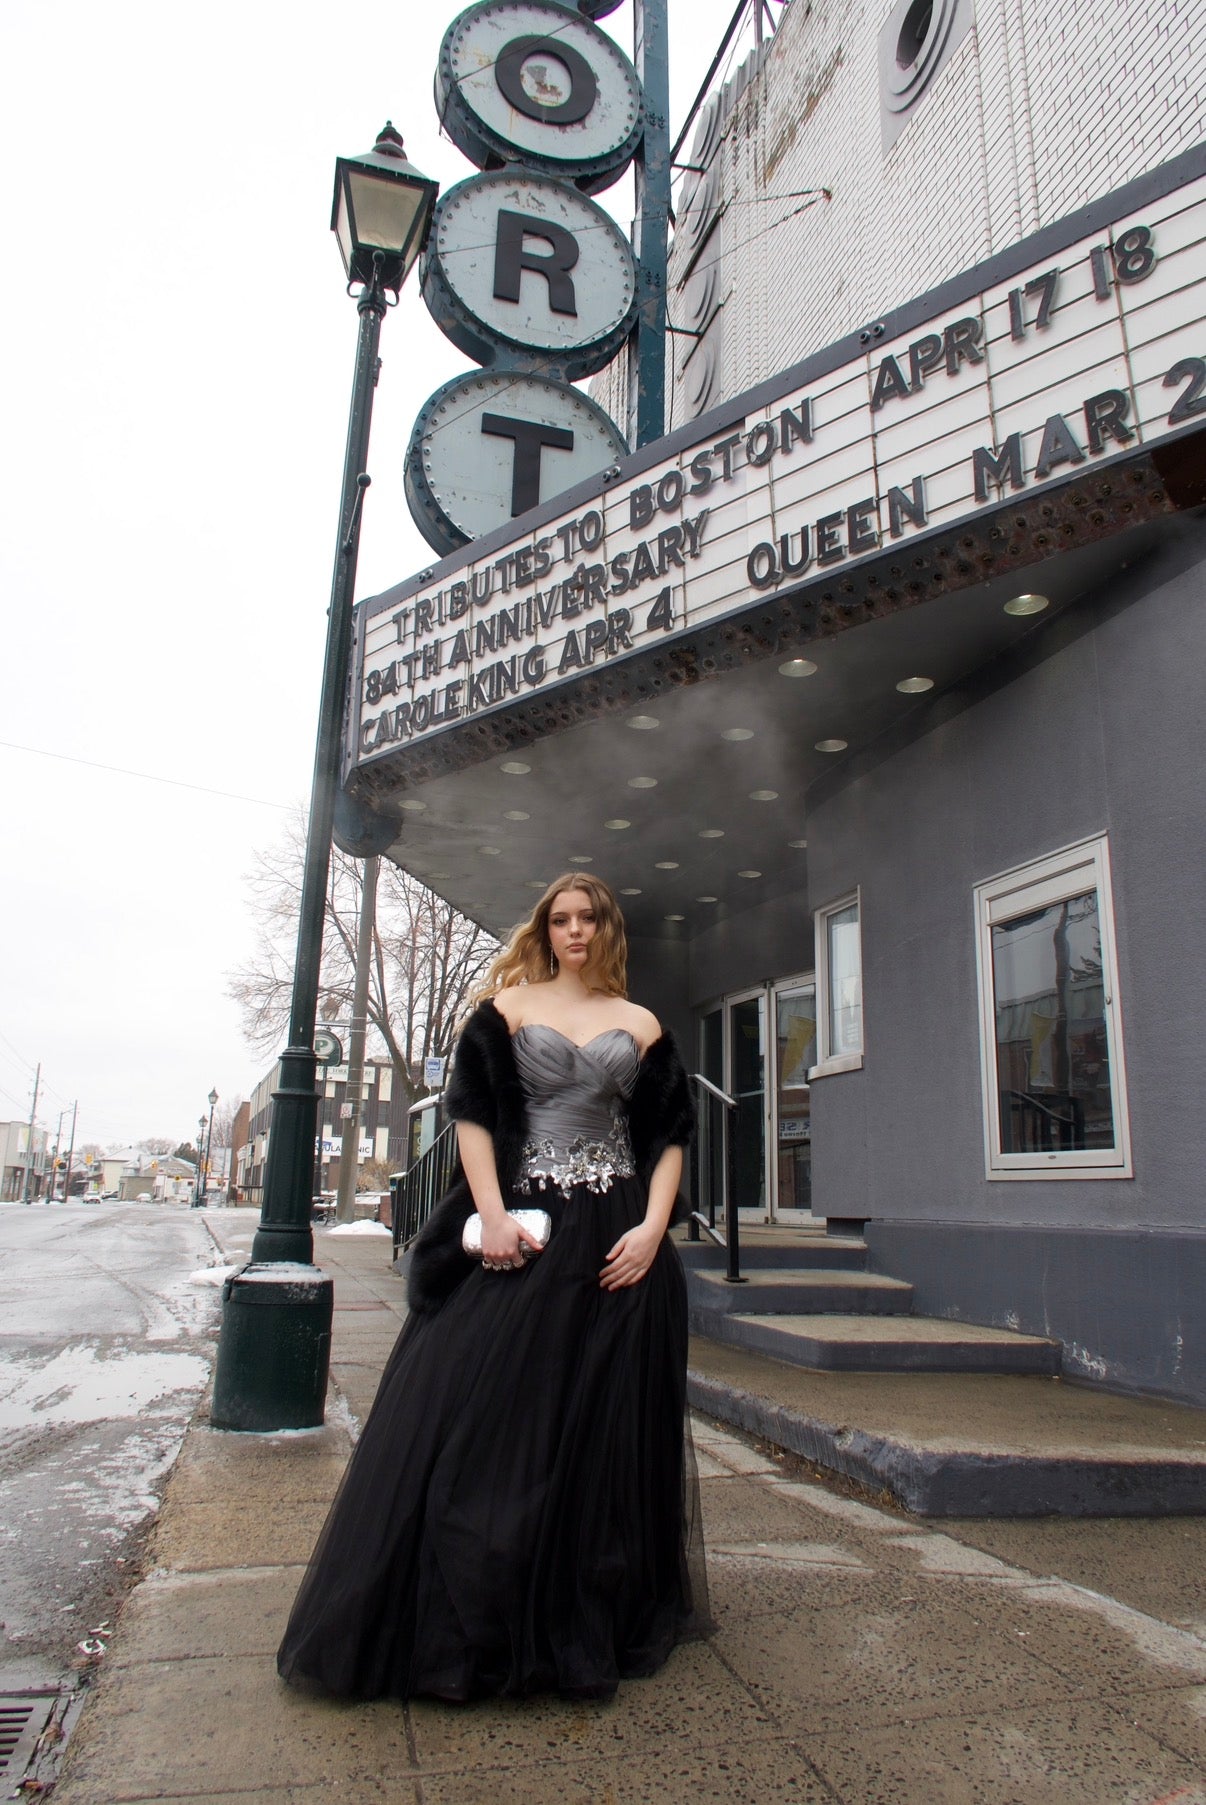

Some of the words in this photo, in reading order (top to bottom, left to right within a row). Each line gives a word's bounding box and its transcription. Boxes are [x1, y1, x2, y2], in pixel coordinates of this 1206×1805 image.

[870, 316, 985, 412] APR
[1007, 267, 1061, 341] 17
[1089, 224, 1158, 302] 18
[392, 537, 554, 646] TRIBUTES
[556, 509, 605, 563] TO
[630, 397, 815, 531] BOSTON
[746, 474, 929, 591] QUEEN
[972, 388, 1134, 503] MAR
[360, 684, 462, 754] CAROLE
[467, 645, 547, 713] KING
[557, 607, 634, 675] APR
[646, 586, 677, 632] 4
[366, 638, 440, 706] 84TH
[448, 507, 710, 669] ANNIVERSARY
